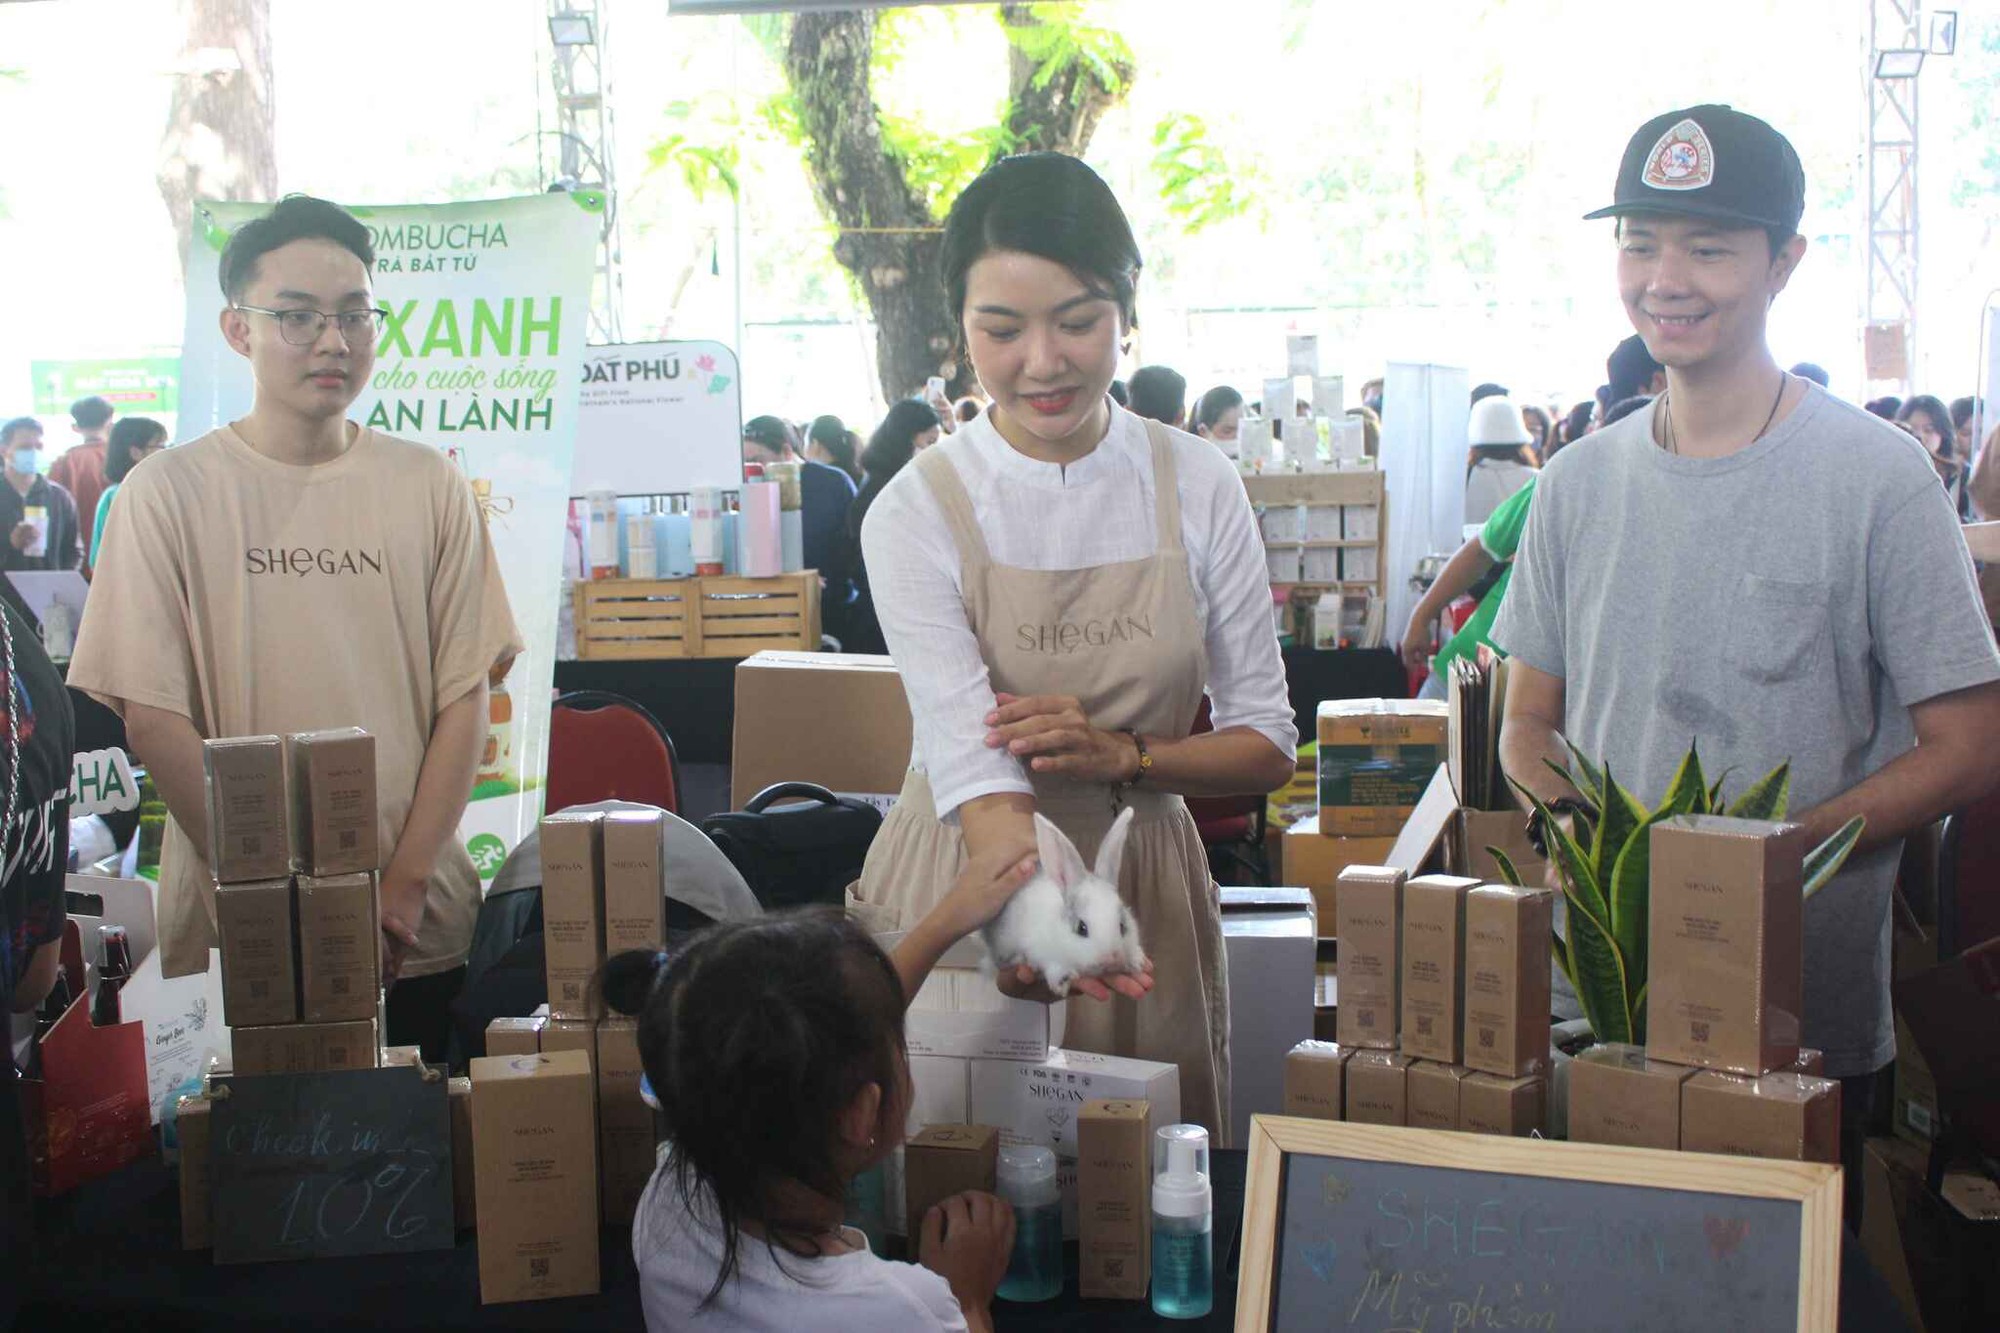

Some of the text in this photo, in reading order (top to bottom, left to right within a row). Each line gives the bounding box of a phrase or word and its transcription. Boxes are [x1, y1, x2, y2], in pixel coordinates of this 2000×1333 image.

[376, 296, 562, 358] XANH
[372, 358, 558, 404] cho cuộc sống
[626, 351, 680, 382] PHÚ
[366, 392, 553, 432] AN LÀNH
